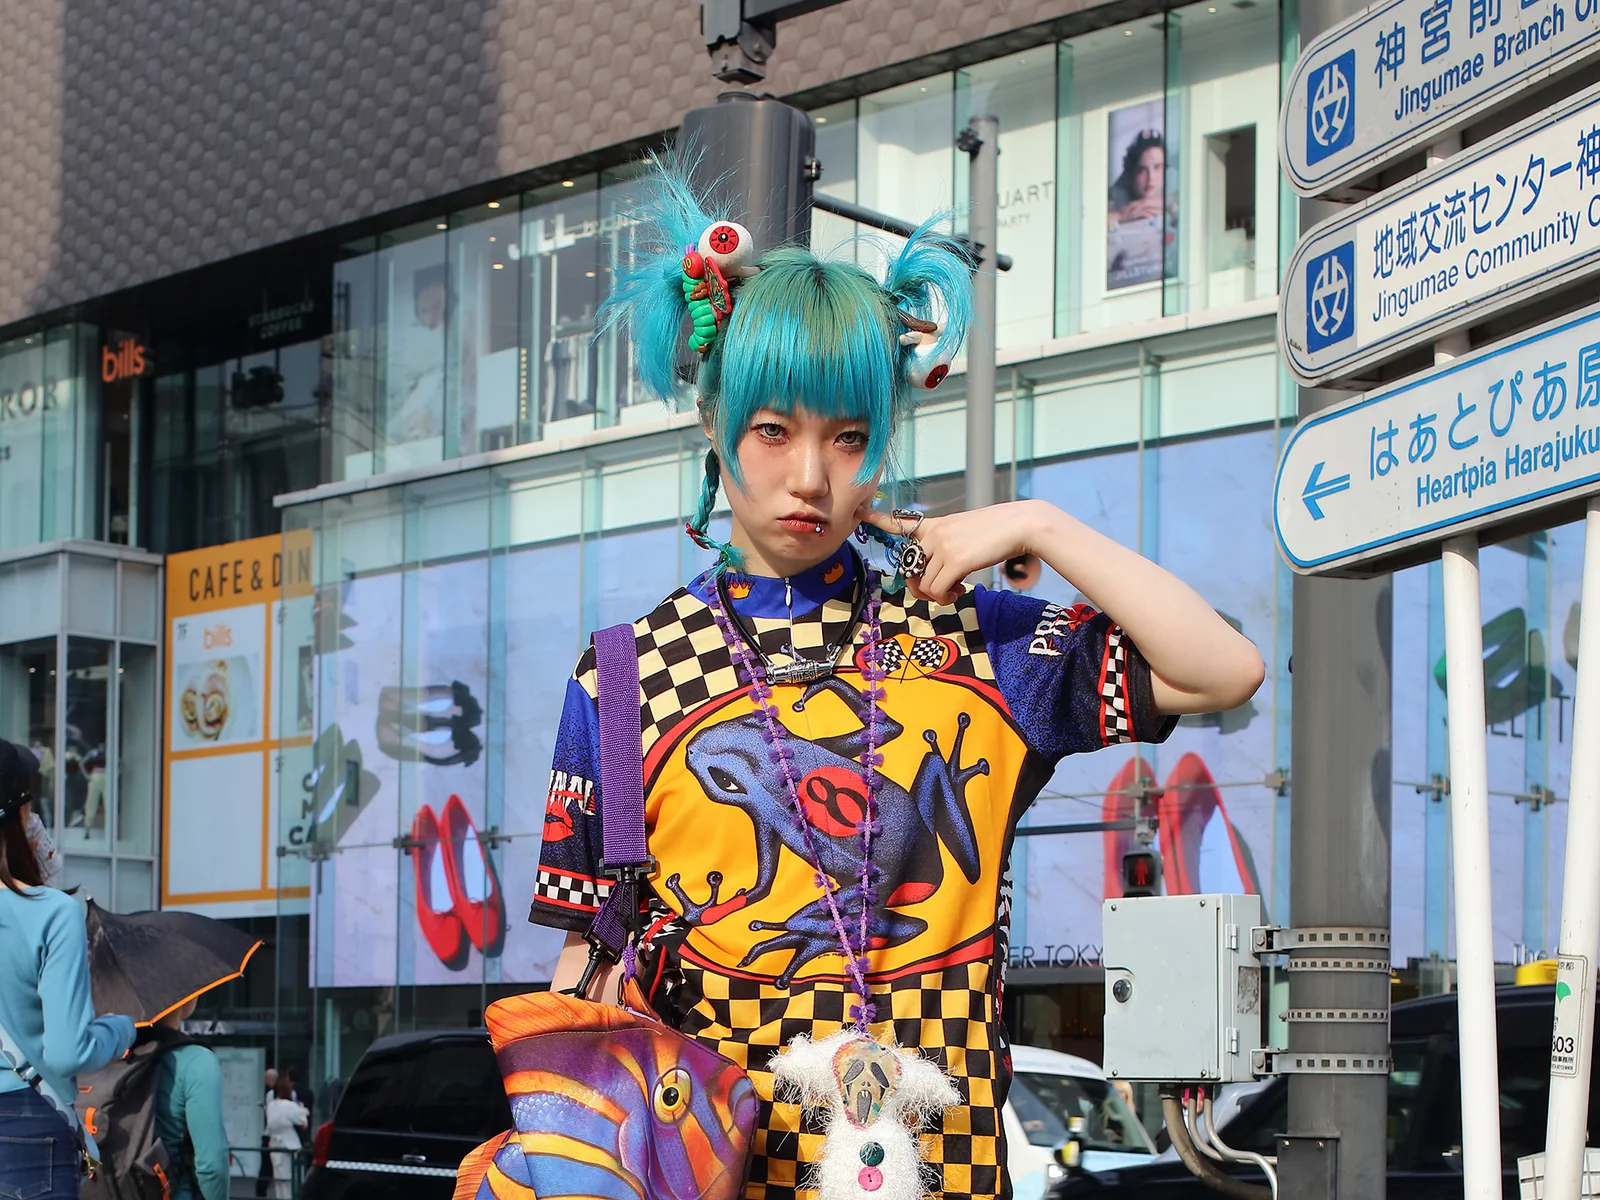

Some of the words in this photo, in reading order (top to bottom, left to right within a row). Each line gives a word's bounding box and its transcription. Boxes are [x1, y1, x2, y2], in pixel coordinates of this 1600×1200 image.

[1374, 0, 1539, 89] 神宮前
[1394, 53, 1485, 120] Jingumae
[1493, 3, 1564, 67] Branch
[1373, 265, 1459, 322] Jingumae
[1465, 210, 1582, 279] Community
[102, 338, 146, 383] bills
[1369, 342, 1600, 480] はあとぴあ原
[1416, 457, 1497, 507] Heartpia
[1505, 424, 1600, 480] Harajuku
[189, 559, 244, 602] CAFE
[250, 559, 264, 591] &
